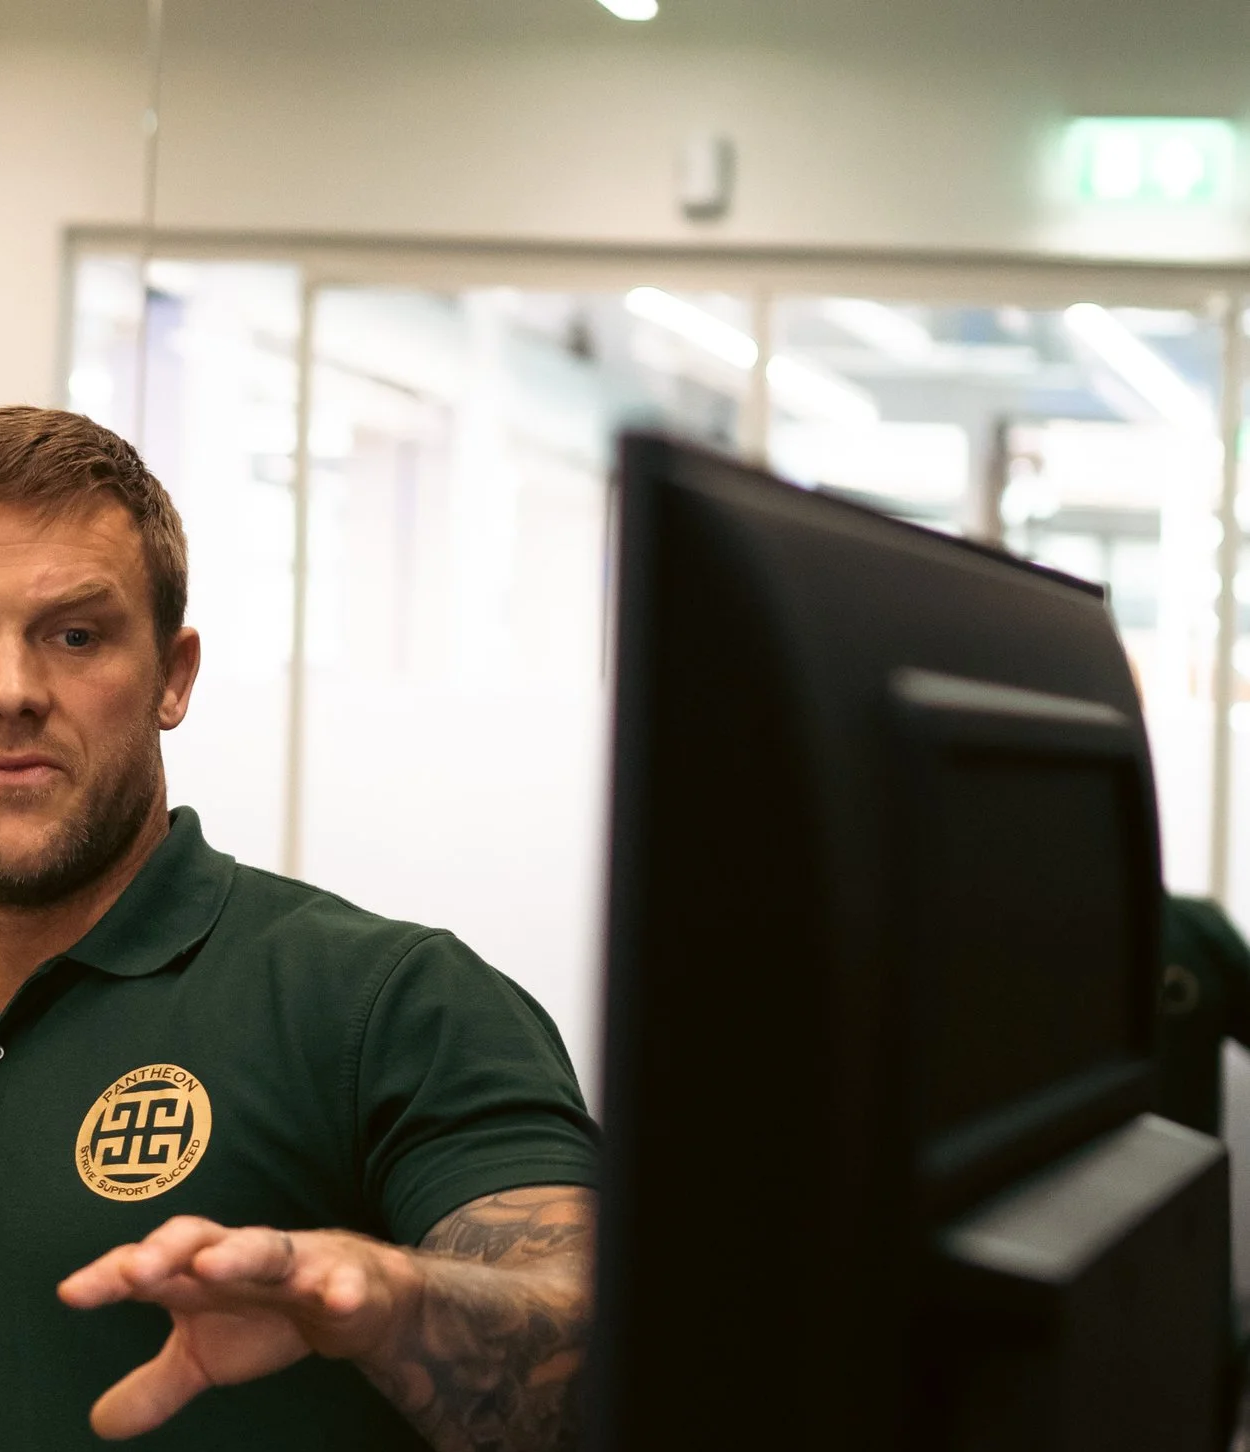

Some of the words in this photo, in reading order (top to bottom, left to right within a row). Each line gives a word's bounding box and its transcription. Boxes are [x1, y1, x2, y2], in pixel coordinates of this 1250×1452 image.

[103, 1067, 198, 1103] PANTHEON
[80, 1145, 97, 1181] STRIVE
[96, 1179, 150, 1195] SUPPORT
[156, 1139, 200, 1188] SUCCEED
